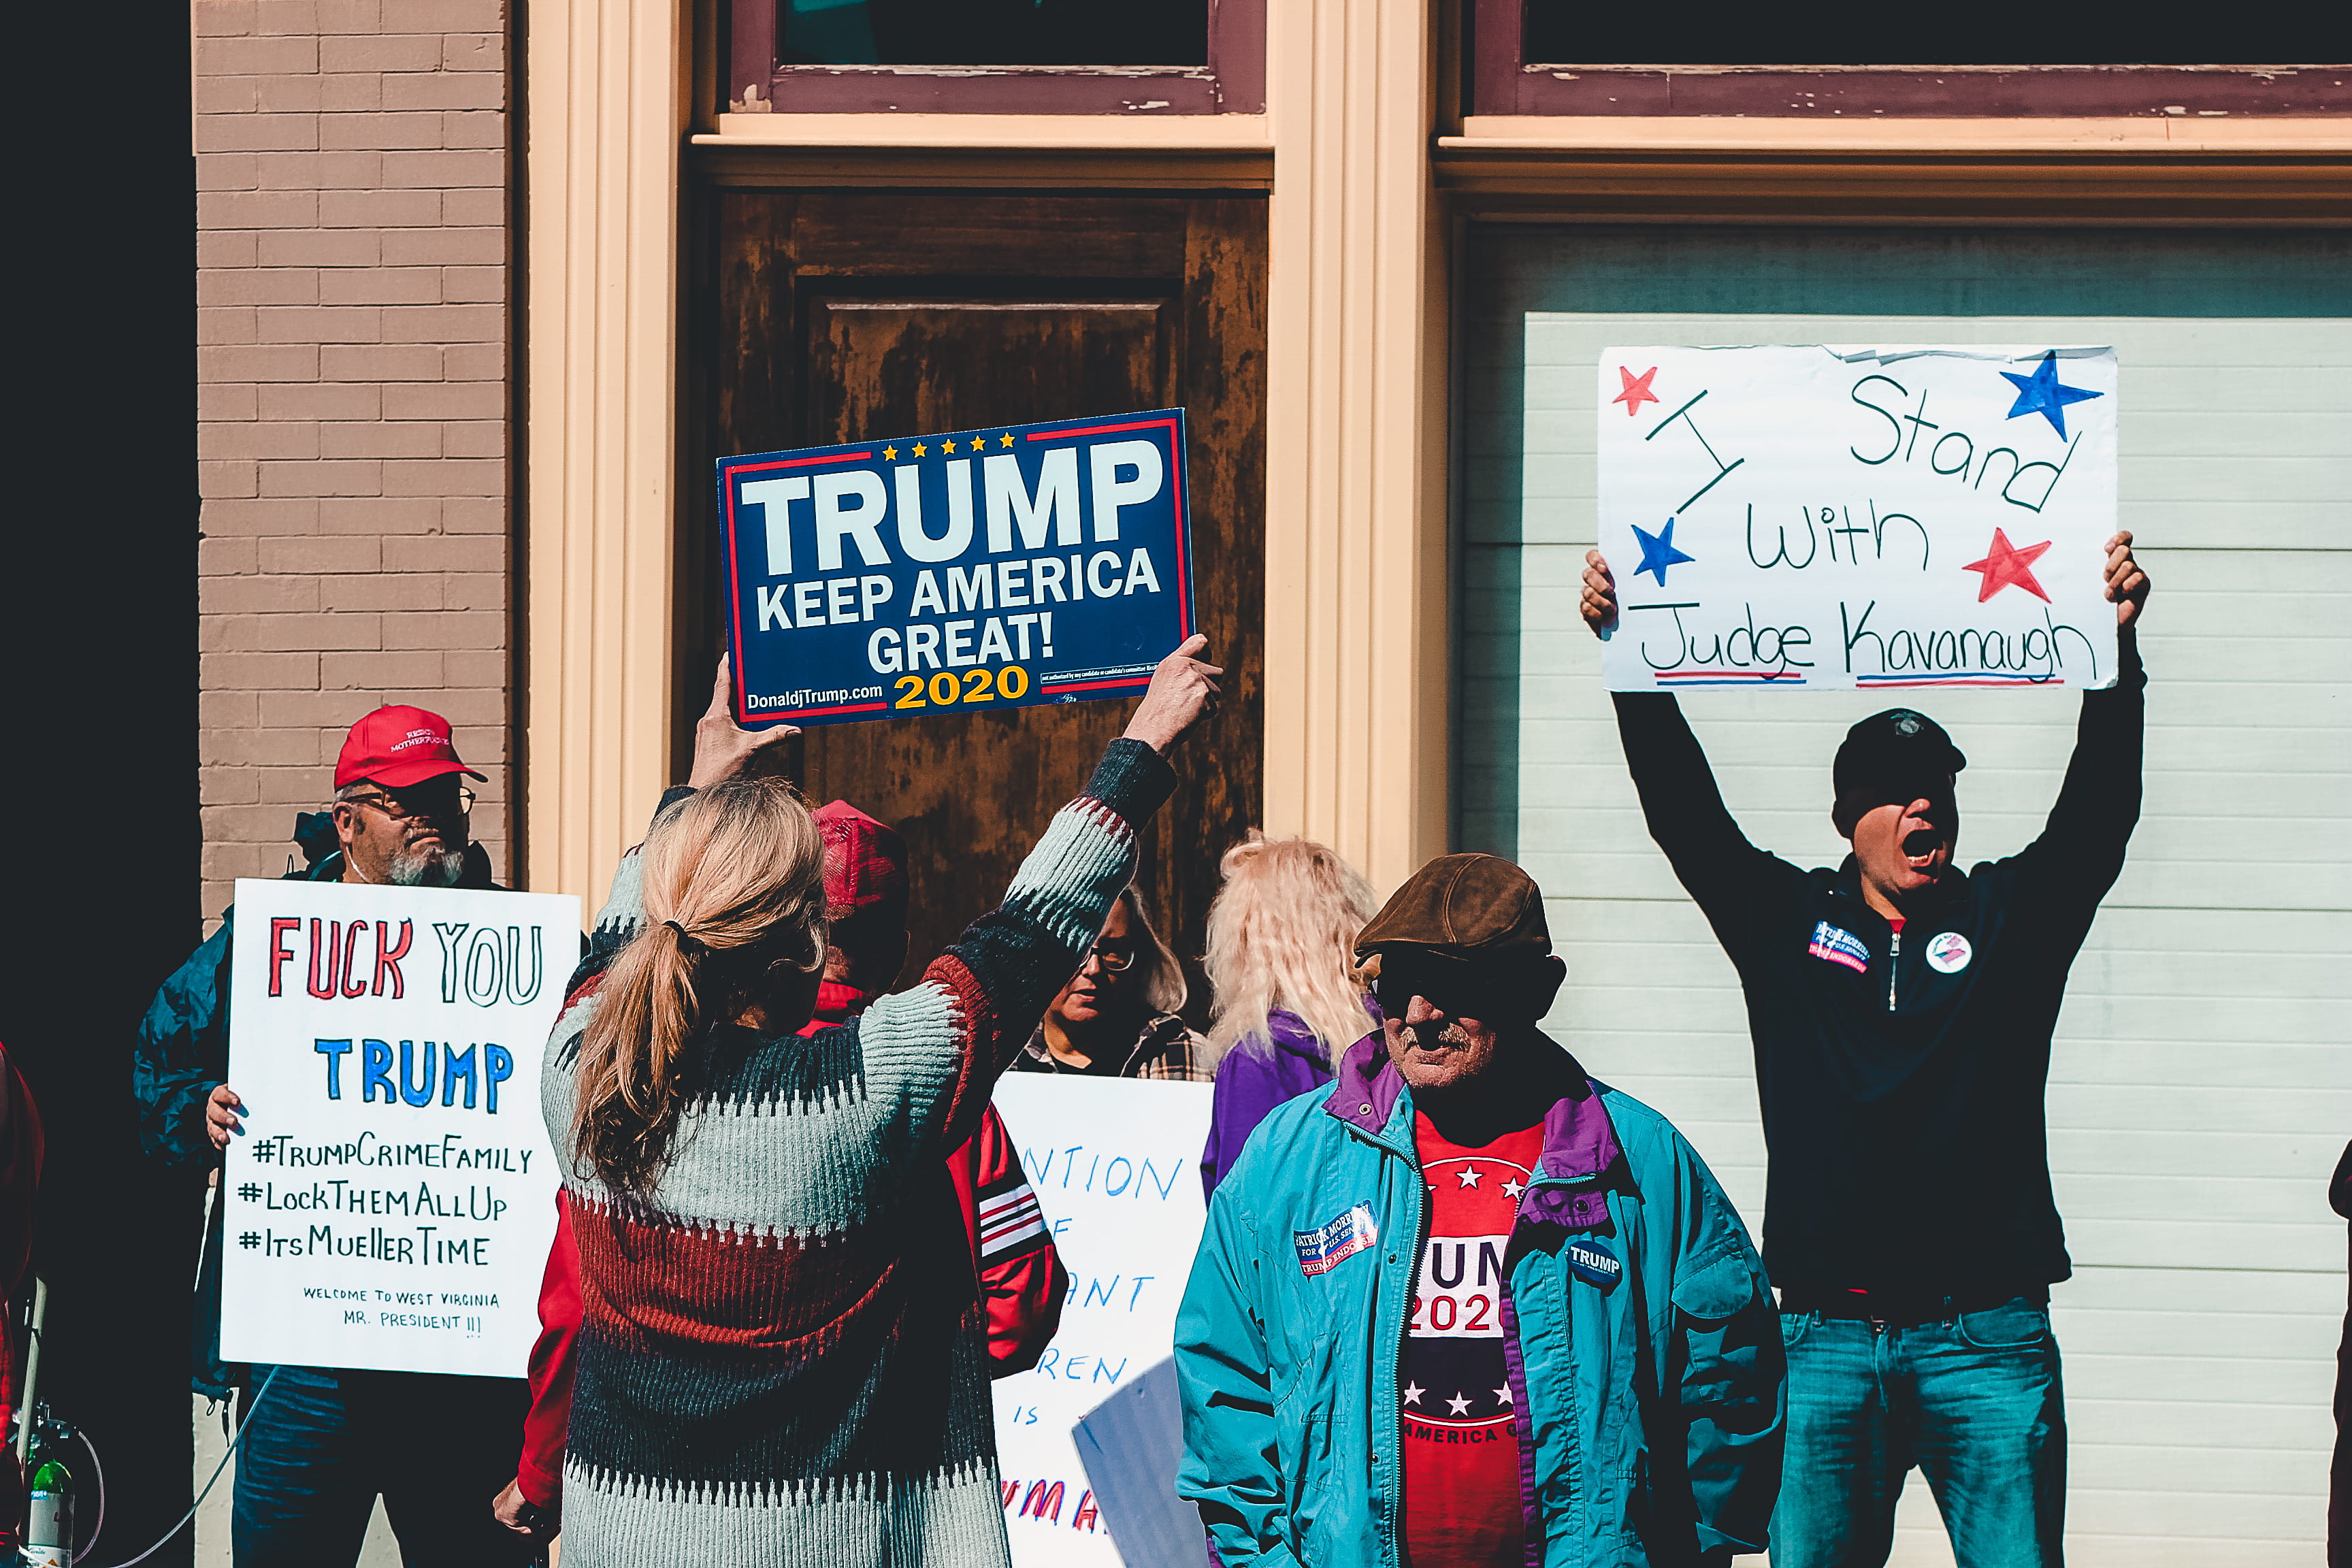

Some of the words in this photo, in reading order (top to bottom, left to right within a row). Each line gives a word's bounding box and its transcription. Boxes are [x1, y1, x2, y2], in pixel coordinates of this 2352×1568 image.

[1646, 390, 1744, 514] I
[1851, 375, 2082, 513] Stand
[740, 440, 1164, 576] TRUMP
[757, 574, 894, 632] KEEP
[909, 547, 1161, 617] AMERICA
[867, 611, 1054, 674] GREAT!
[1628, 602, 1815, 681] Judge
[1840, 600, 2097, 683] Kavanaugh
[747, 683, 883, 710] DonaldjTrump.com
[894, 665, 1029, 710] 2020
[268, 916, 413, 1000] FUCK
[433, 922, 543, 1007] YOU
[314, 1038, 514, 1115] TRUMP
[1023, 1145, 1183, 1200] NTION
[1301, 1248, 1317, 1256] FOR
[1570, 1245, 1620, 1274] TRUMP
[304, 1287, 367, 1301] WELCOME
[374, 1290, 391, 1302] TO
[396, 1292, 434, 1305] WEST
[441, 1293, 500, 1308] VIRGINIA
[1068, 1271, 1156, 1313] ANT
[344, 1310, 371, 1325] MR.
[380, 1312, 461, 1329] PRESIDENT
[1037, 1348, 1127, 1384] REN
[1013, 1406, 1038, 1425] IS
[1001, 1479, 1099, 1534] UMA
